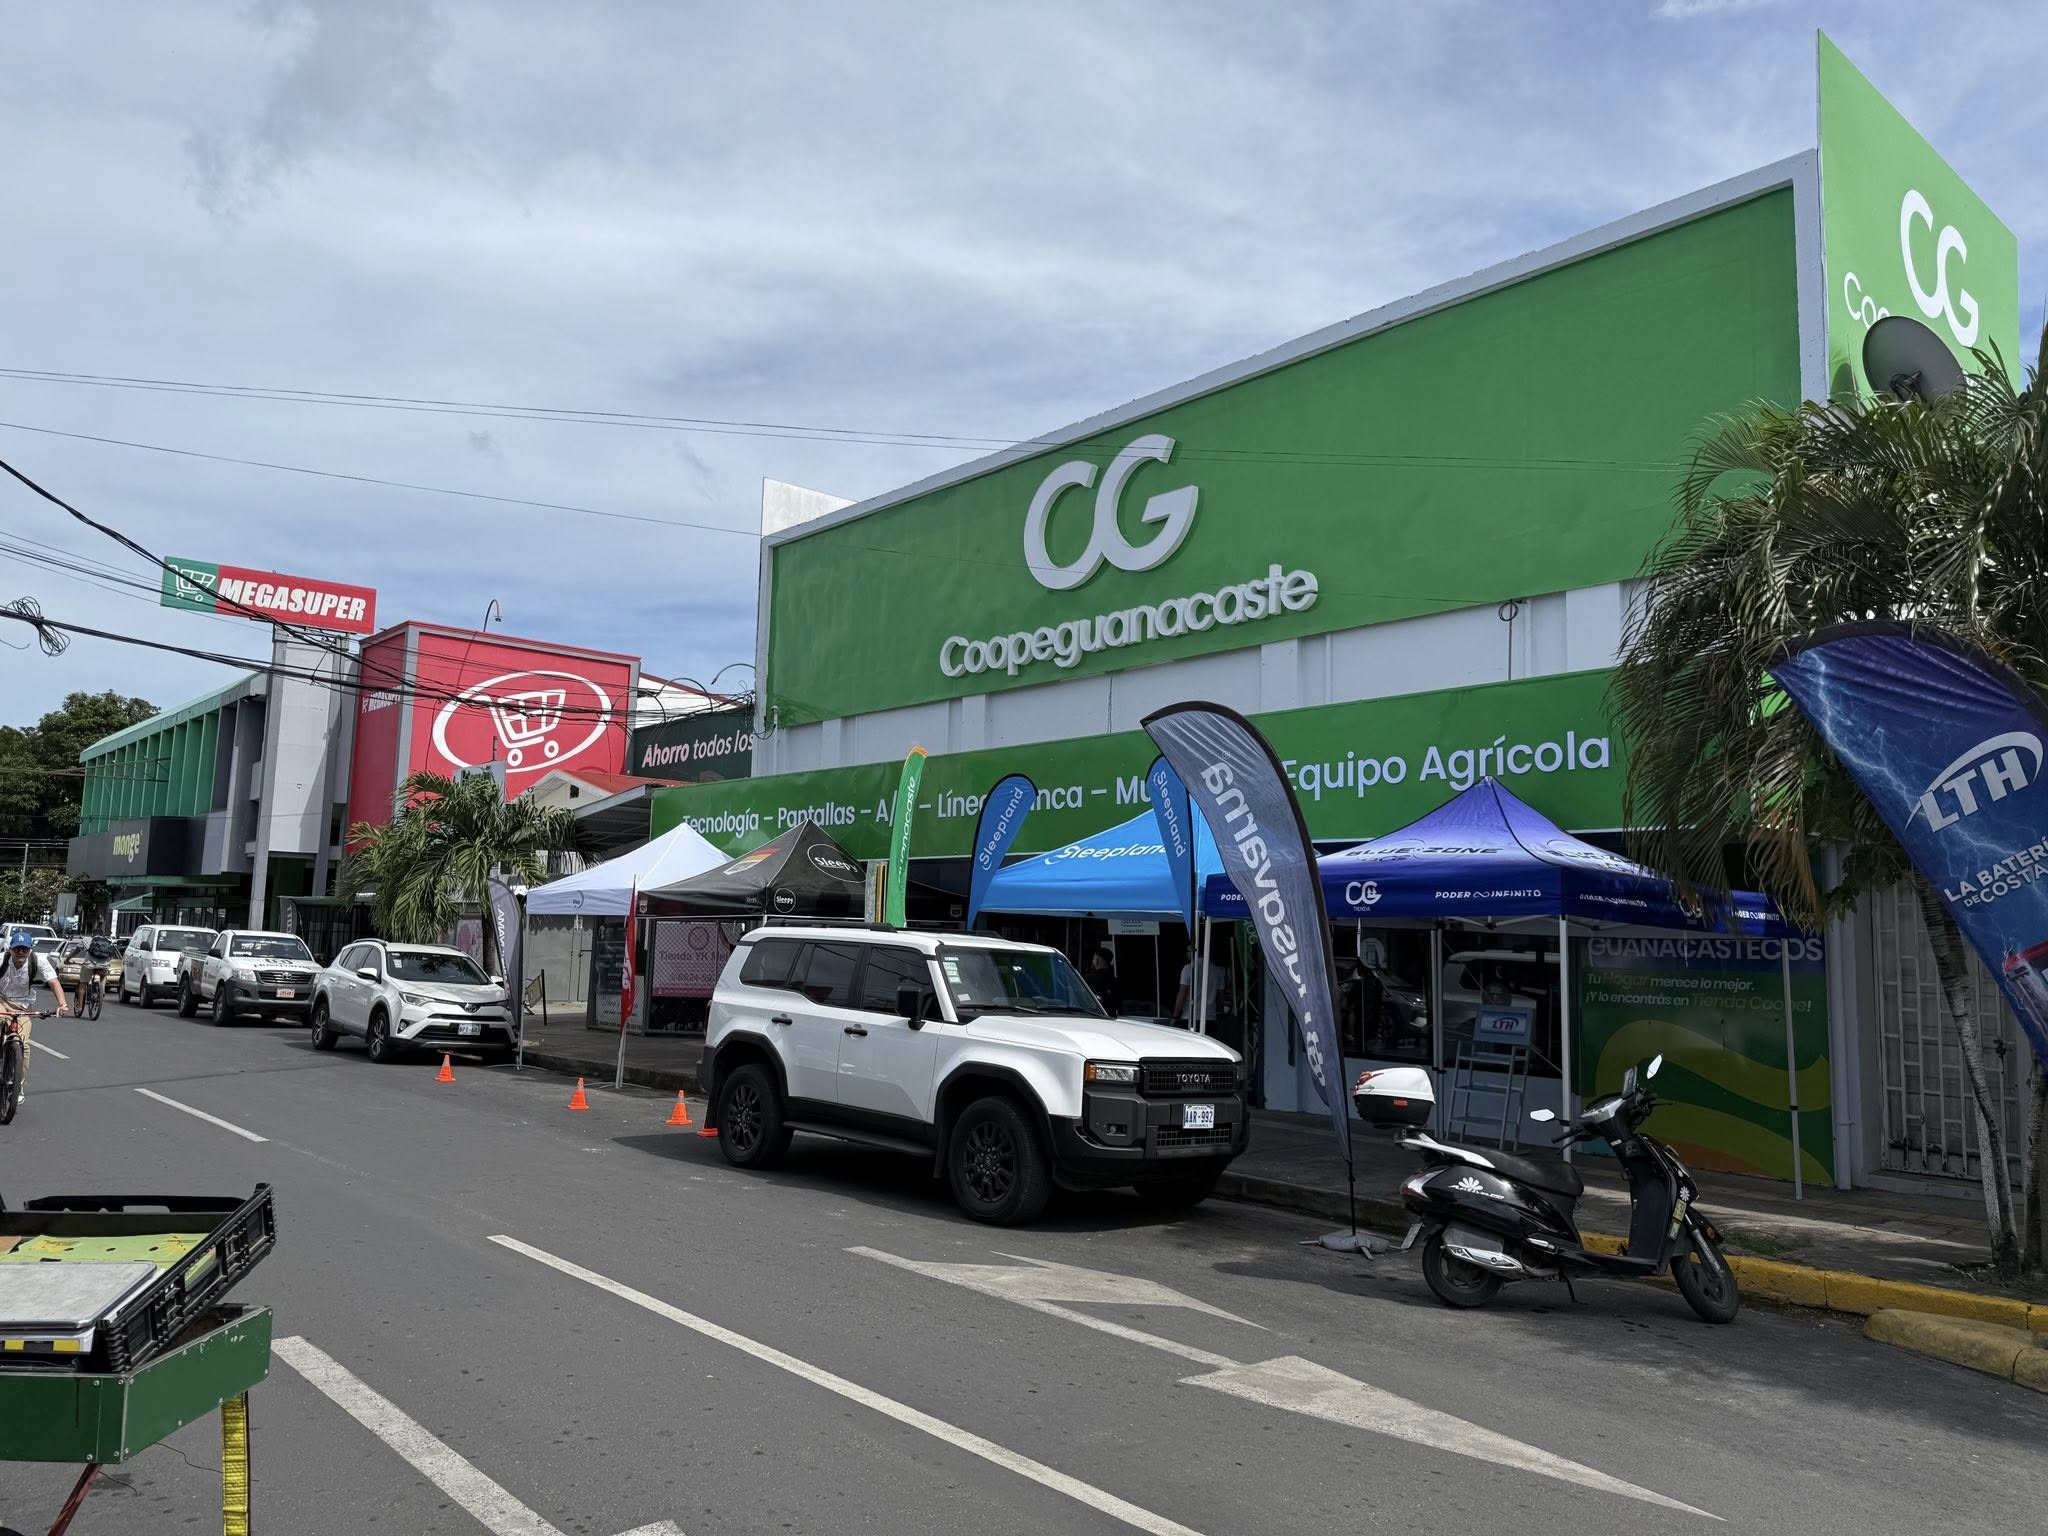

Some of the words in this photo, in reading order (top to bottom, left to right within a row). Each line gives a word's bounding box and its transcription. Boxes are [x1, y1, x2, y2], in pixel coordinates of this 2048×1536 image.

[1023, 433, 1198, 590] CG
[218, 577, 367, 621] MEGASUPER
[940, 563, 1319, 678] Coopeguanacaste
[692, 734, 731, 760] todos
[682, 807, 759, 839] Tecnología
[778, 802, 855, 829] Pantallas
[1280, 750, 1408, 801] Equipo
[1419, 730, 1610, 791] Agrícola
[1919, 749, 2029, 832] LTH
[979, 786, 1024, 866] Sleepland
[1154, 770, 1187, 858] Sleepland
[112, 833, 140, 863] monge
[814, 856, 858, 873] Sleepy
[1434, 891, 1471, 899] PODER
[1491, 889, 1542, 898] INFINITO
[1943, 880, 1977, 903] LA
[1588, 937, 1824, 962] GUANACASTECOS
[1587, 973, 1601, 985] Tu
[1601, 972, 1650, 990] Hogar
[1651, 976, 1699, 988] merece
[1700, 976, 1711, 985] lo
[1713, 978, 1755, 991] mejor.
[1598, 991, 1610, 1002] lo
[1610, 991, 1671, 1004] encontrás
[1672, 995, 1689, 1006] en
[1492, 1020, 1514, 1030] LTH
[1176, 1073, 1211, 1083] TOYOTA
